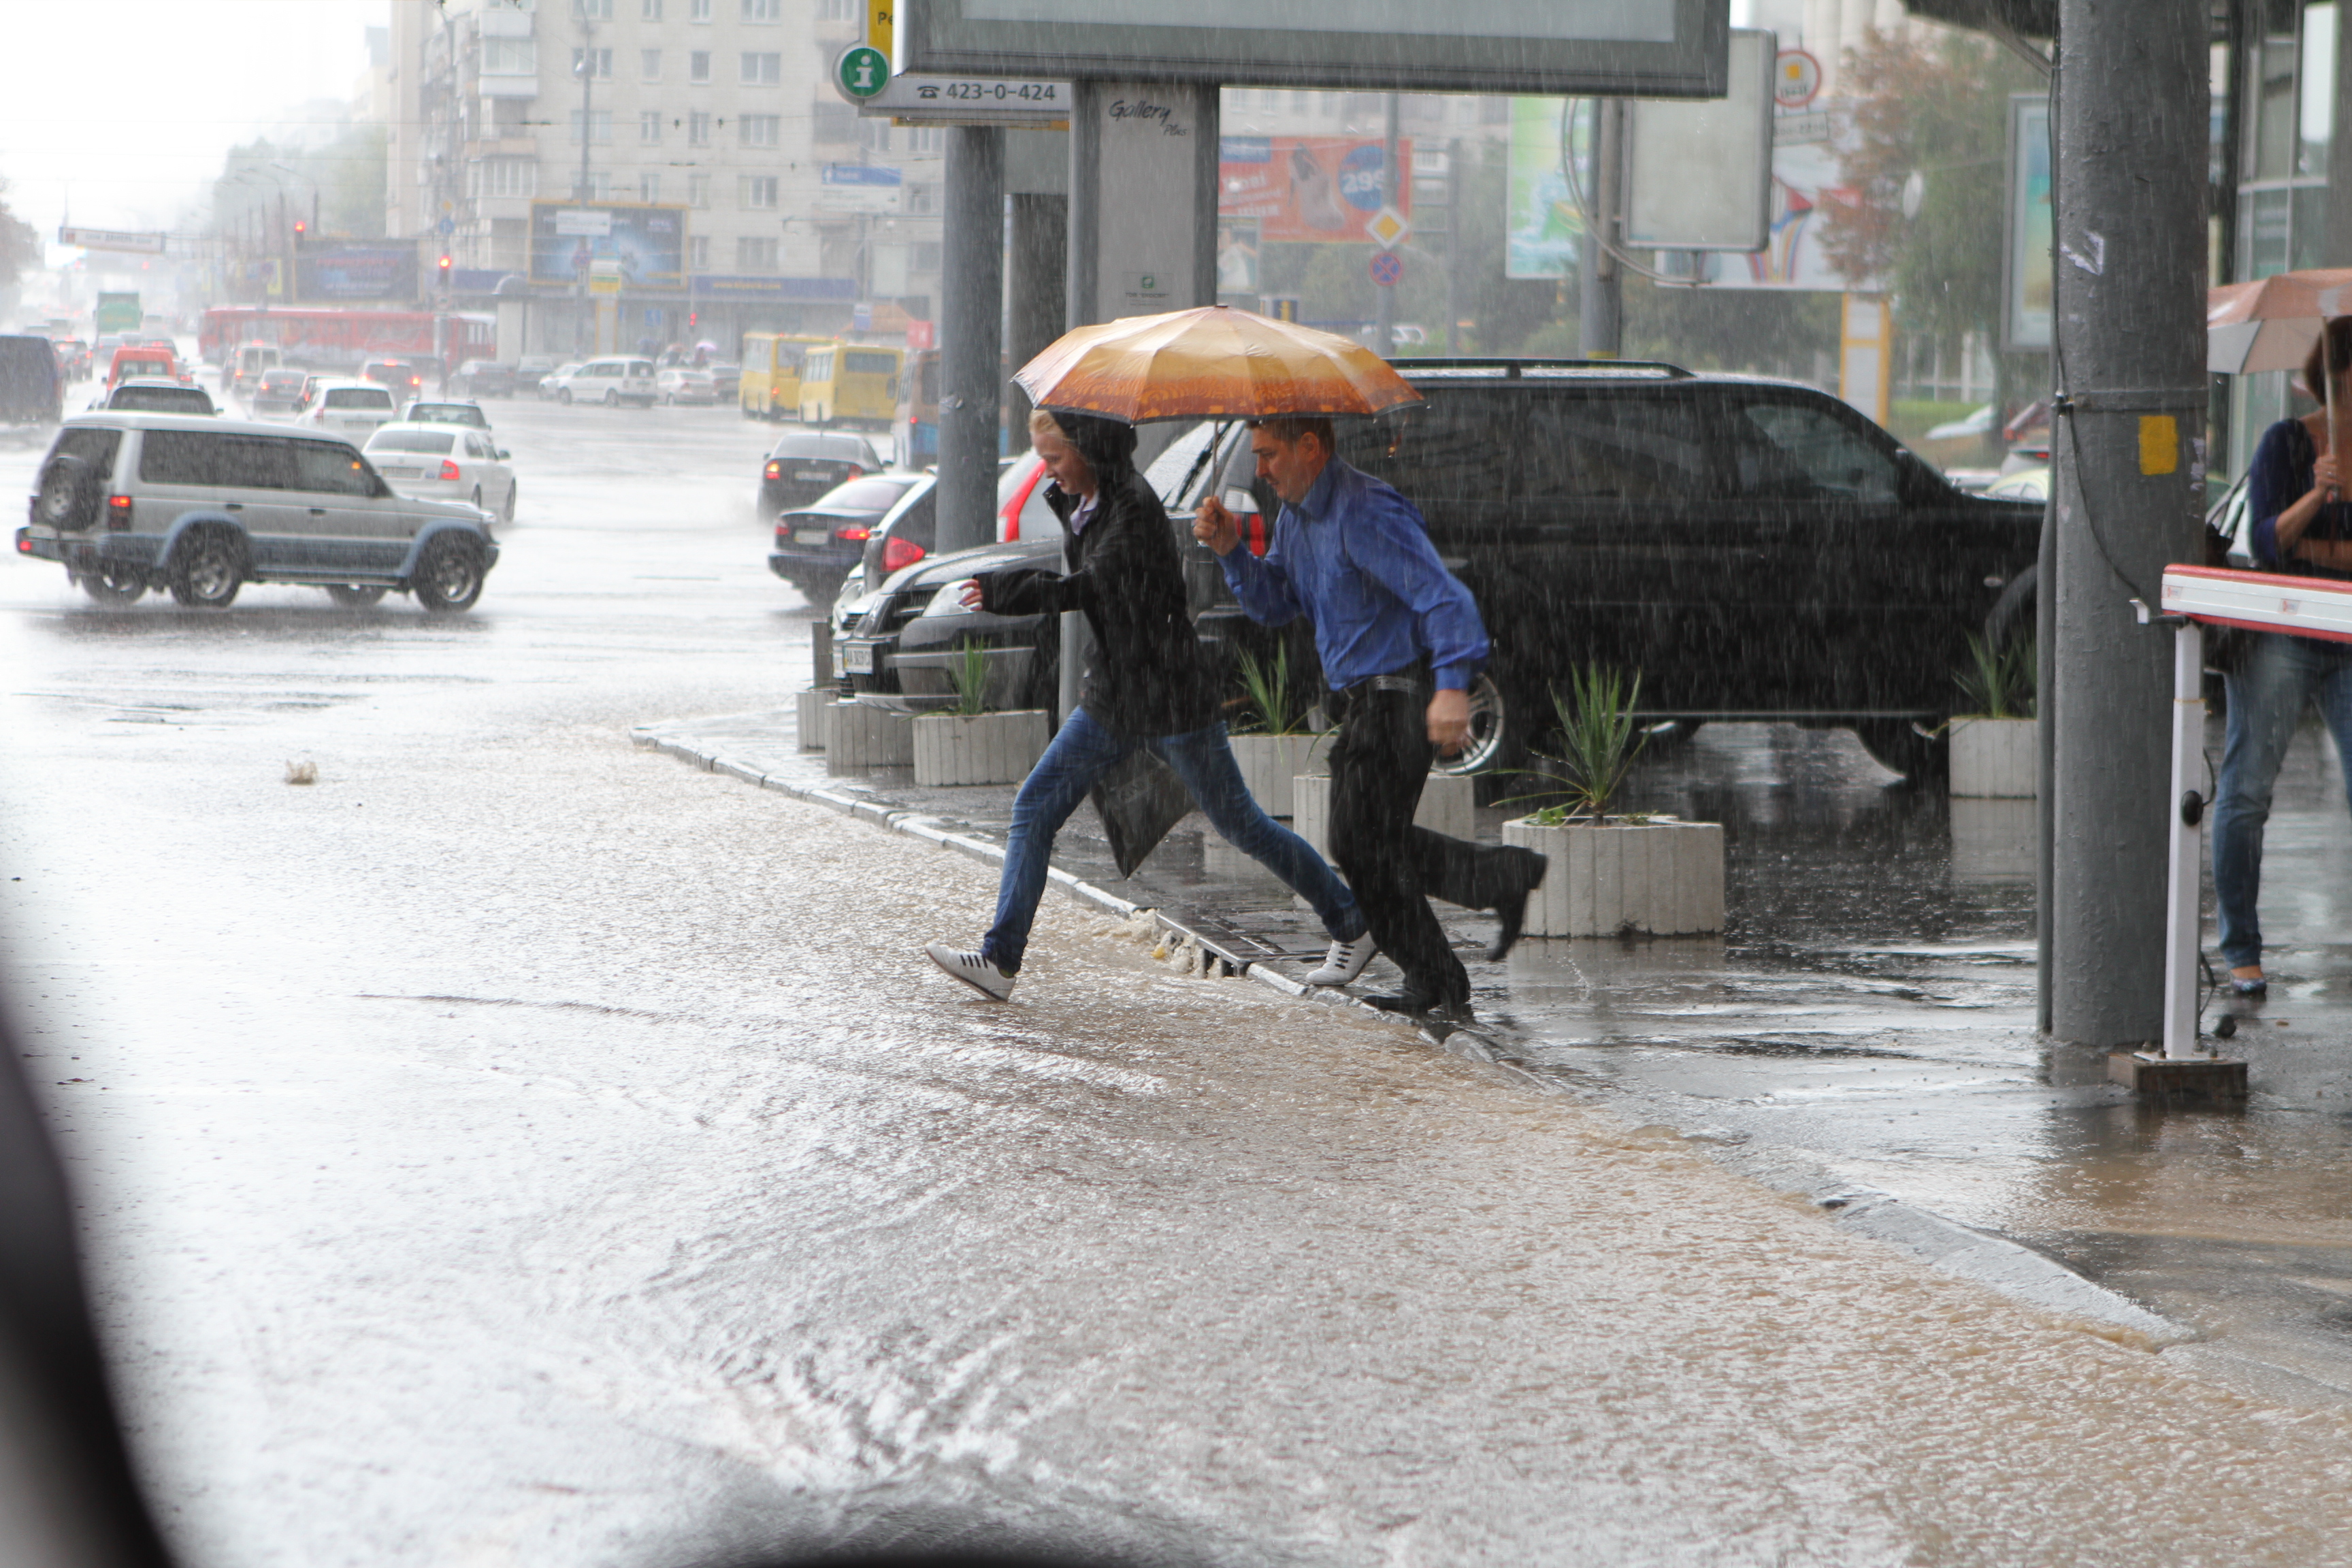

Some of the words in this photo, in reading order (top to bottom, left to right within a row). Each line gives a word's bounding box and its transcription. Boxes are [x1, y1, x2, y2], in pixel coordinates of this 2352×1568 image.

[946, 82, 1056, 101] 423-0-424
[1109, 99, 1171, 126] Gallery
[1162, 124, 1188, 136] Plus
